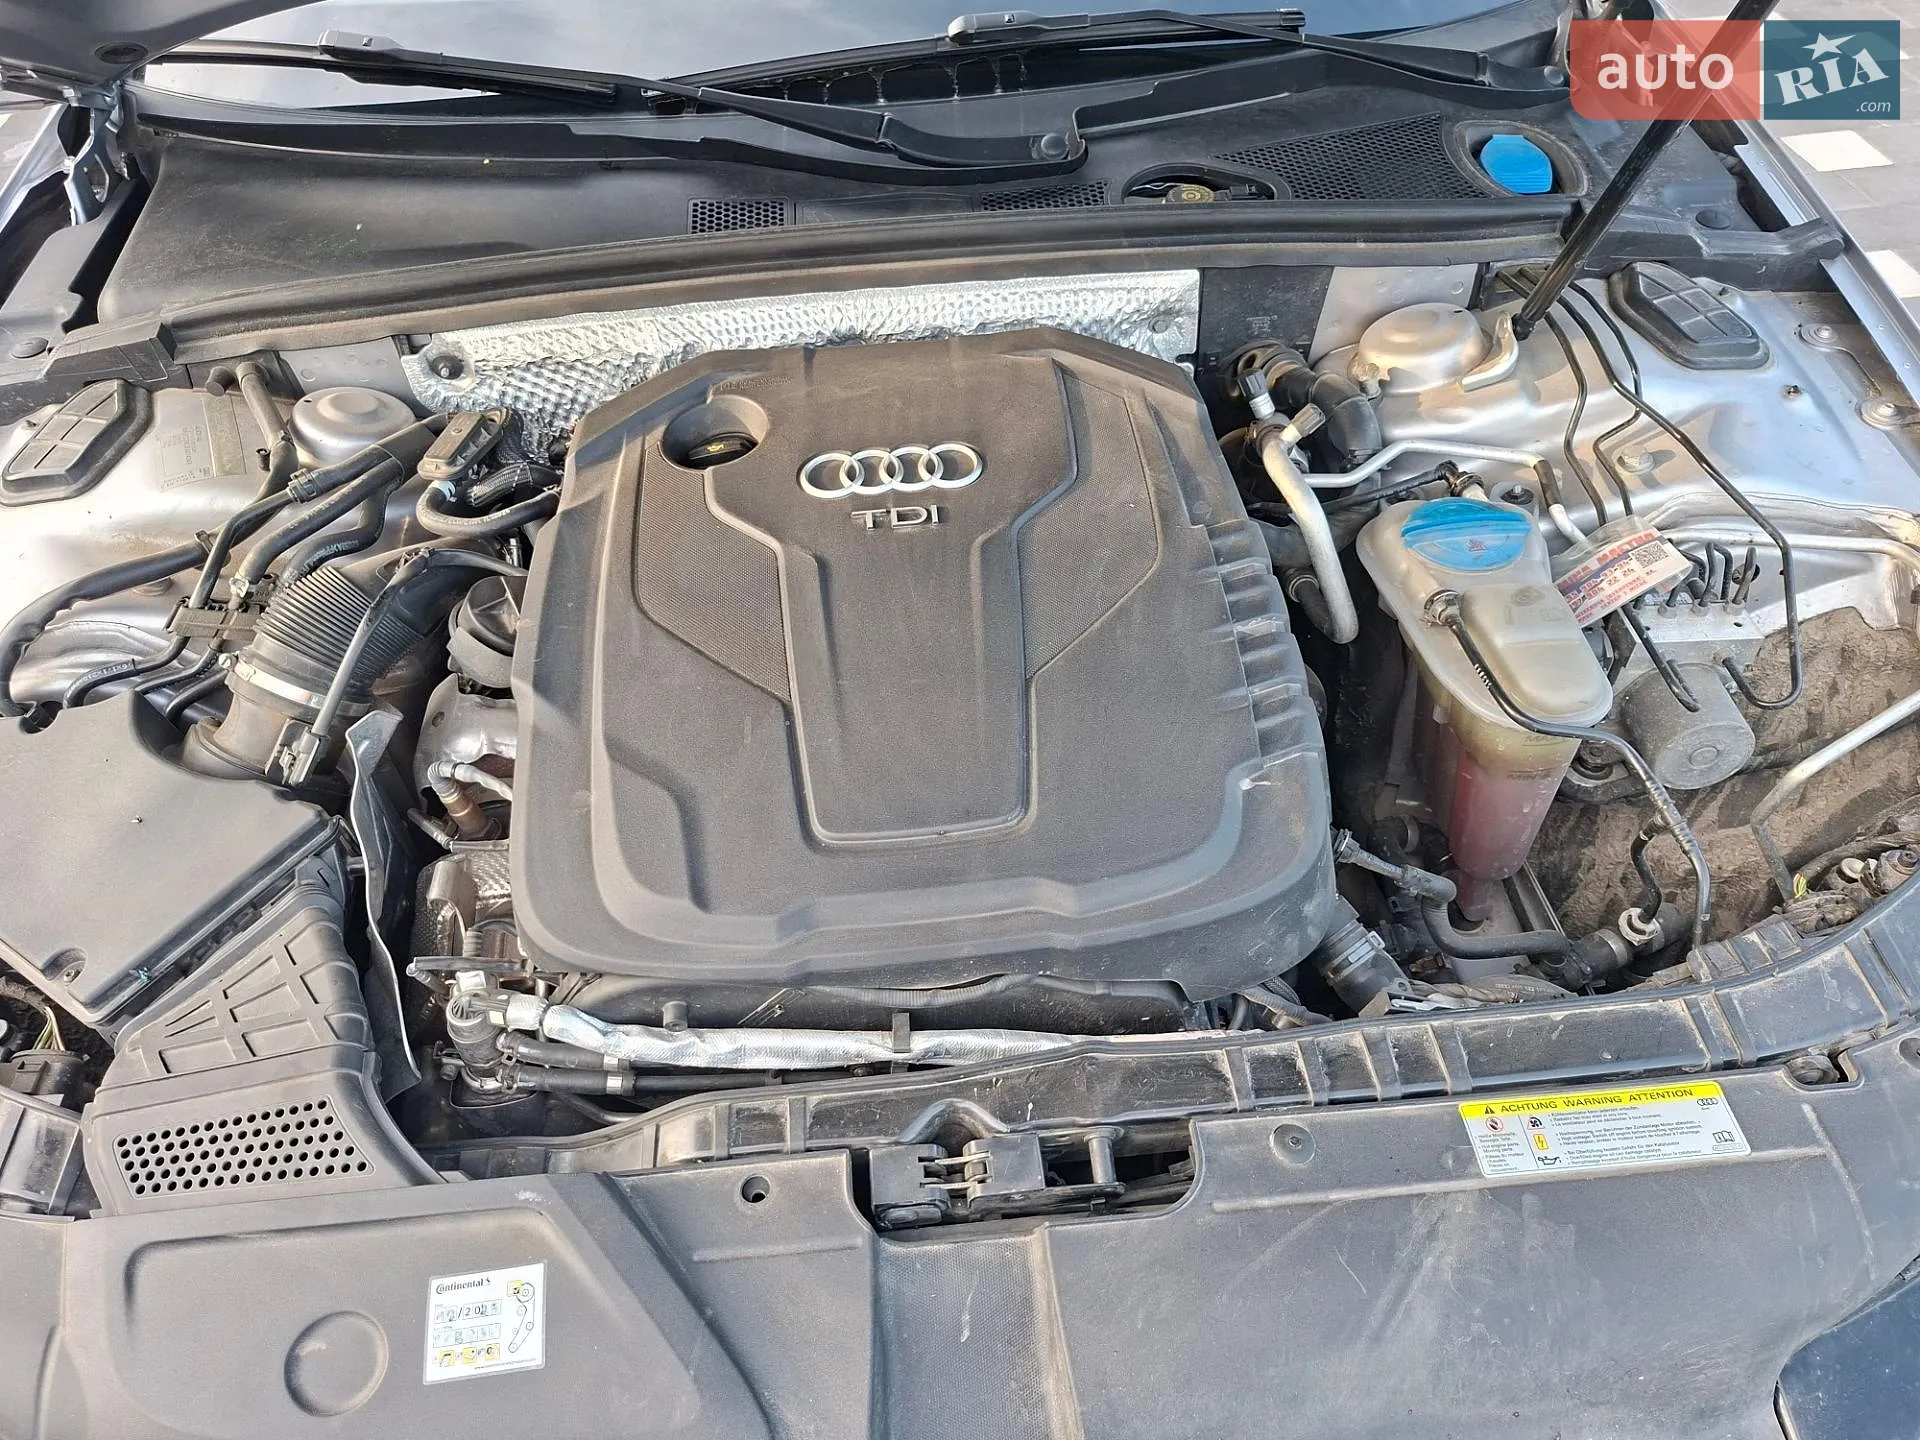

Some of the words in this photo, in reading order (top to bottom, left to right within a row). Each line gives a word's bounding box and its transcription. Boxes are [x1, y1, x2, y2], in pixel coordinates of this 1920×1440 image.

[851, 504, 939, 530] TDI
[1501, 1100, 1558, 1113] ACHTUNG
[1563, 1094, 1623, 1107] WARNING
[1629, 1088, 1694, 1102] ATTENTION
[435, 1278, 484, 1295] Continental
